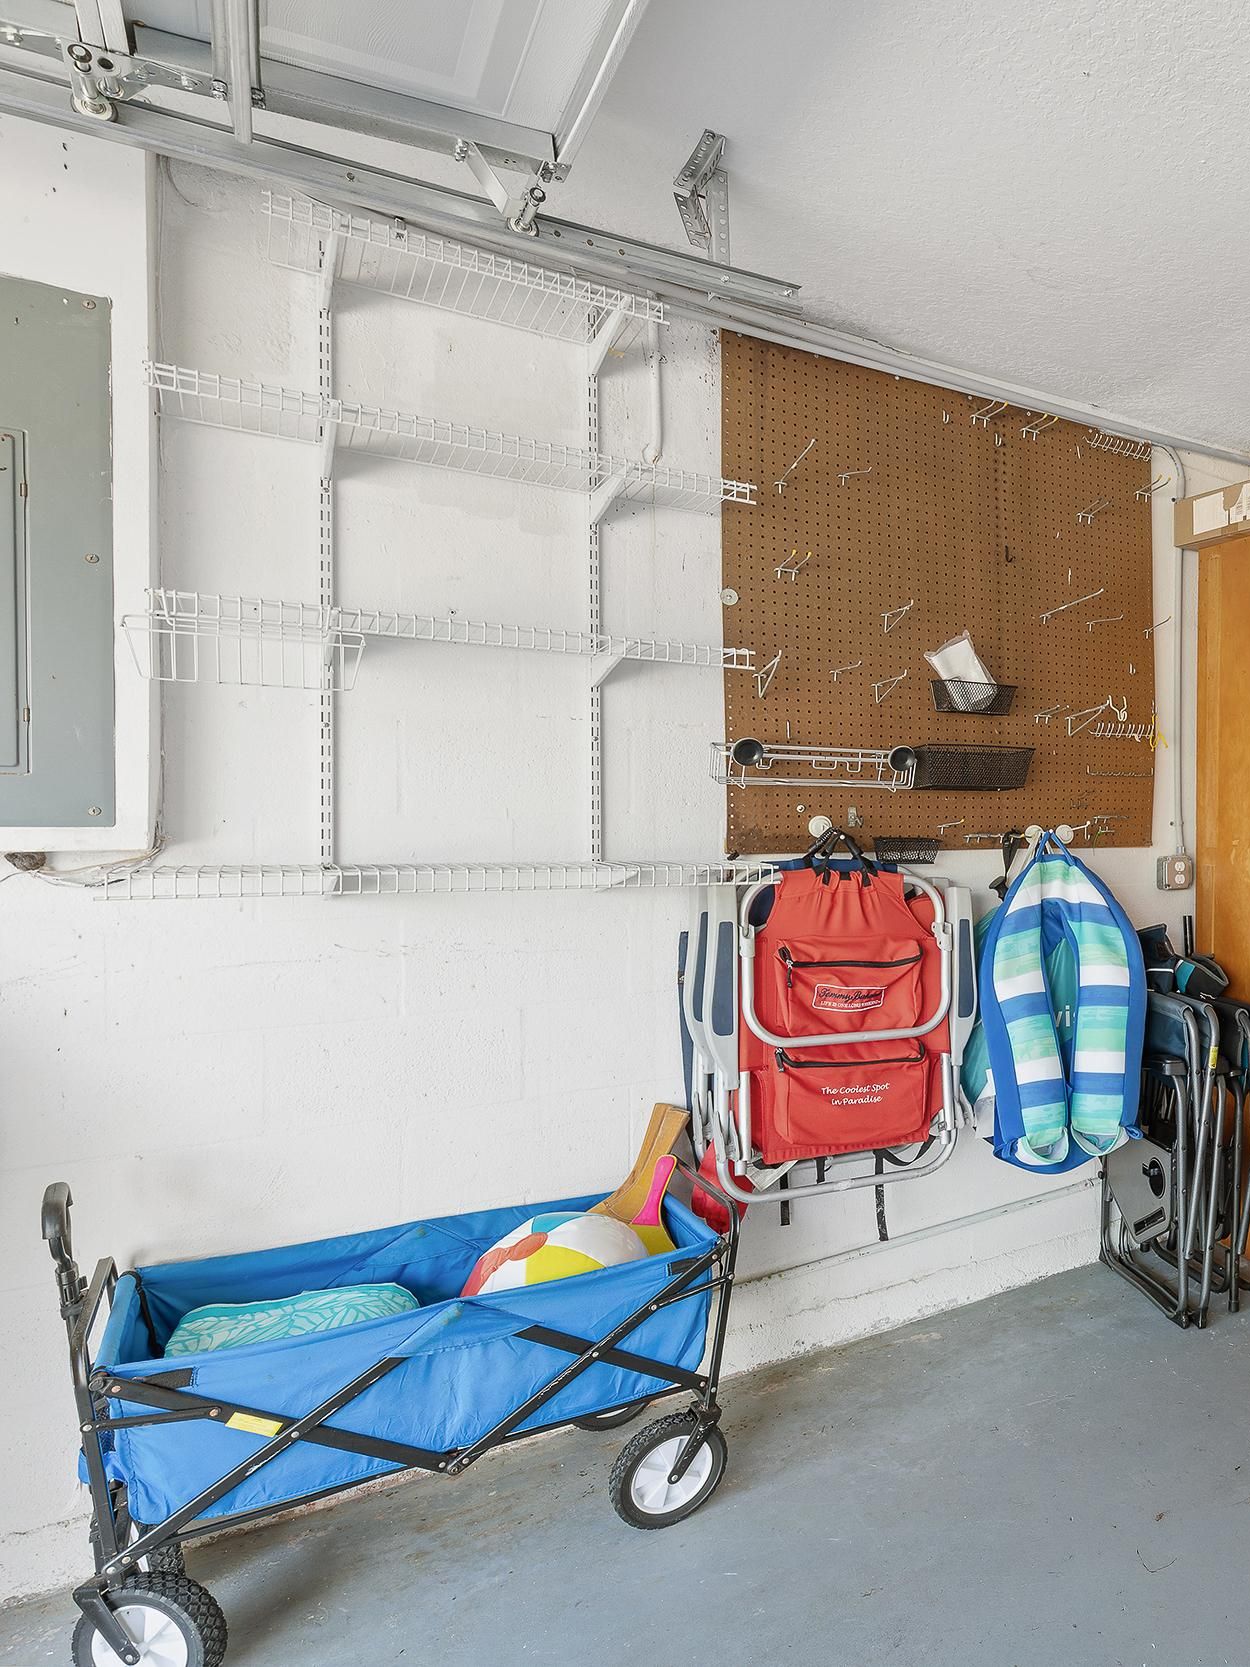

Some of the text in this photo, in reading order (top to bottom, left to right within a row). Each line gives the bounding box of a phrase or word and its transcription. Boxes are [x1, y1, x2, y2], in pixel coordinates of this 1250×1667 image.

[819, 988, 852, 1002] Tommy
[821, 1082, 890, 1095] The Coolest Spot
[843, 1095, 883, 1105] Paradise
